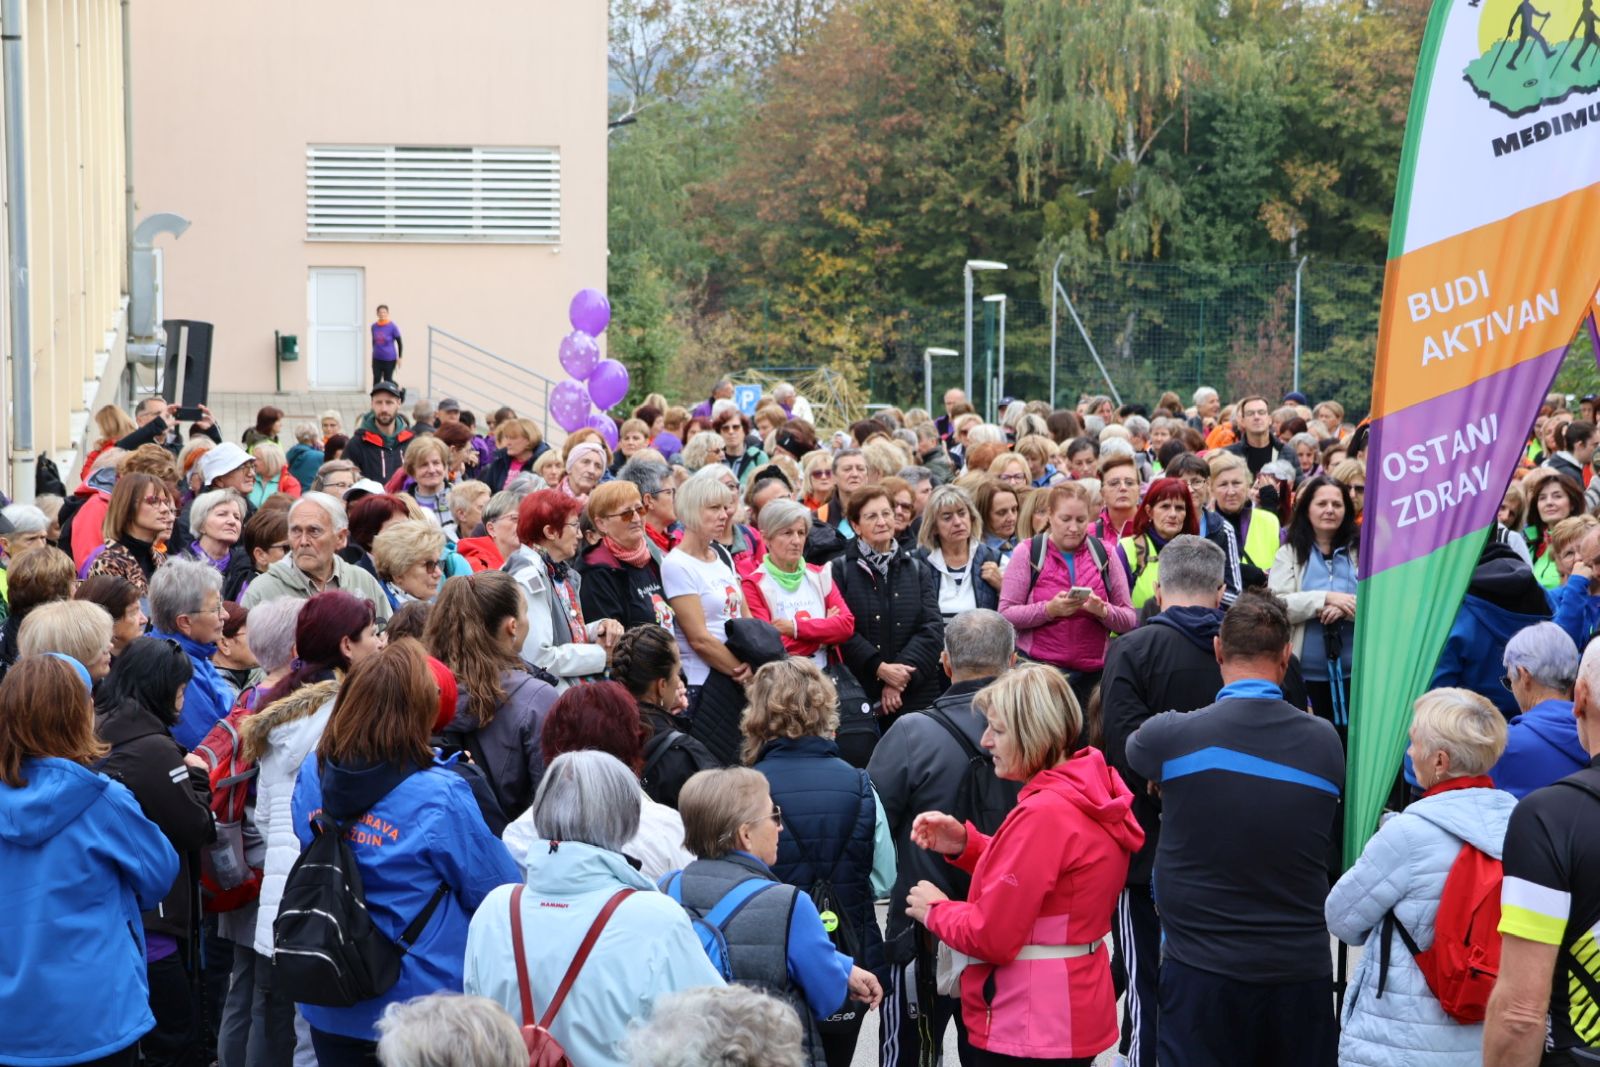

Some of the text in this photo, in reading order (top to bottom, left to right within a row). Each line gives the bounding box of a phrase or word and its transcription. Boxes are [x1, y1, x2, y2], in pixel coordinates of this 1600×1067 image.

[1407, 270, 1490, 322] BUDI
[1421, 288, 1560, 367] AKTIVAN
[741, 390, 754, 410] P
[1382, 413, 1498, 482] OSTANI
[1391, 461, 1491, 528] ZDRAV
